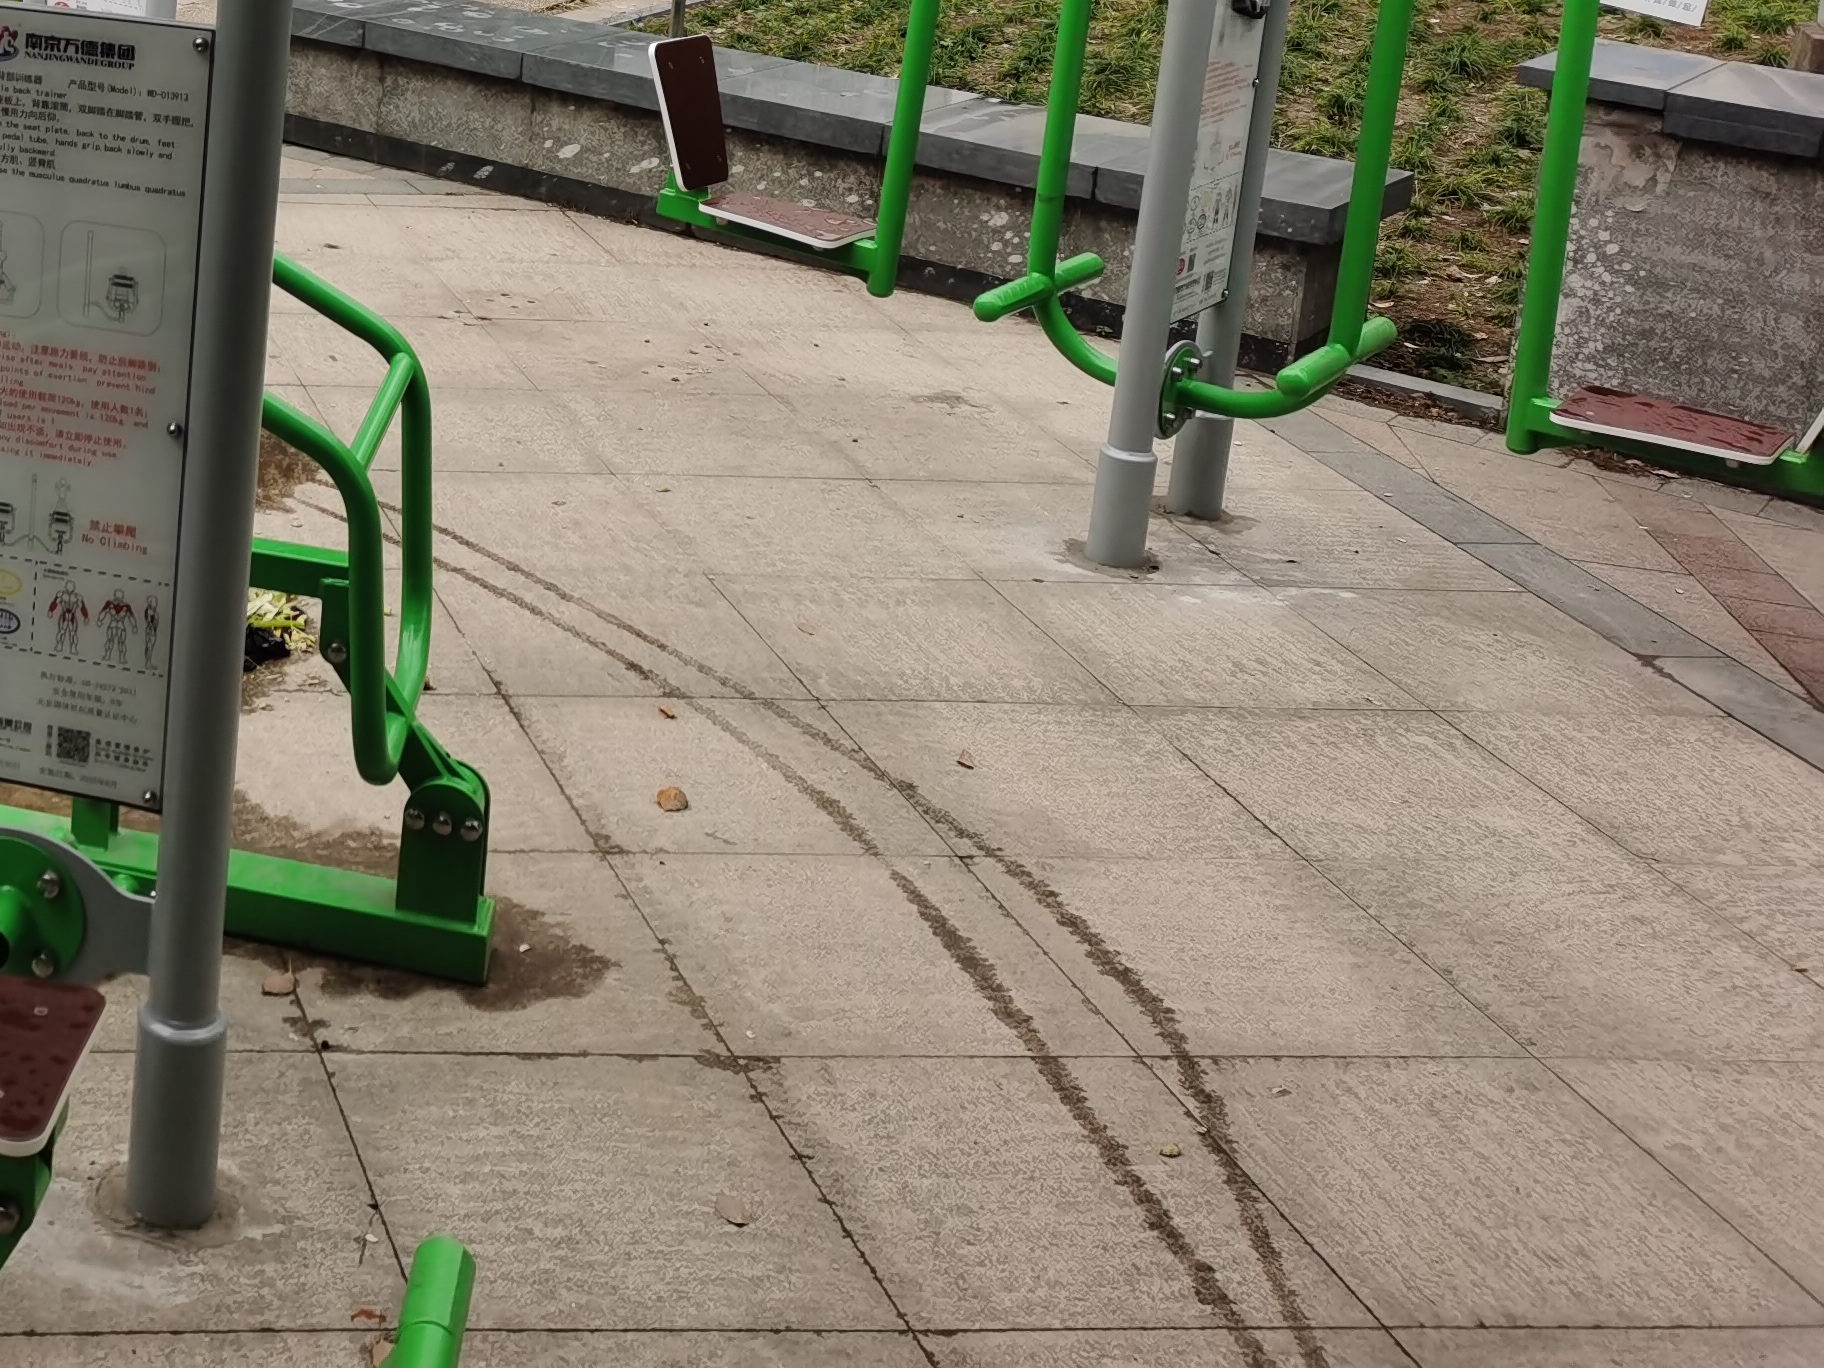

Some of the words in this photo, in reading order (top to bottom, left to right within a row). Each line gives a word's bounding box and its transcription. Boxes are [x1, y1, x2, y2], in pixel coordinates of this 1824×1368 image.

[24, 33, 136, 61] 南京万德集团
[23, 51, 135, 71] NANJINGWANDEGROUP
[12, 85, 31, 95] back
[36, 88, 67, 99] trainer
[2, 131, 24, 142] pedal
[55, 138, 78, 148] hands
[126, 146, 154, 158] slowly
[157, 151, 173, 160] and
[6, 121, 19, 129] the
[22, 123, 41, 132] seat
[76, 129, 94, 139] back
[98, 132, 108, 140] to
[112, 133, 126, 142] the
[156, 138, 175, 149] feet
[18, 145, 55, 156] backward
[11, 168, 25, 177] the
[28, 170, 65, 182] musculus
[68, 175, 109, 188] quadratus
[113, 180, 141, 191] lumbus
[144, 185, 186, 198] quadratus
[0, 364, 29, 376] points
[33, 368, 43, 378] of
[82, 365, 98, 375] pay
[21, 403, 36, 412] per
[132, 419, 148, 429] and
[80, 533, 94, 545] No
[98, 536, 148, 556] Climbing
